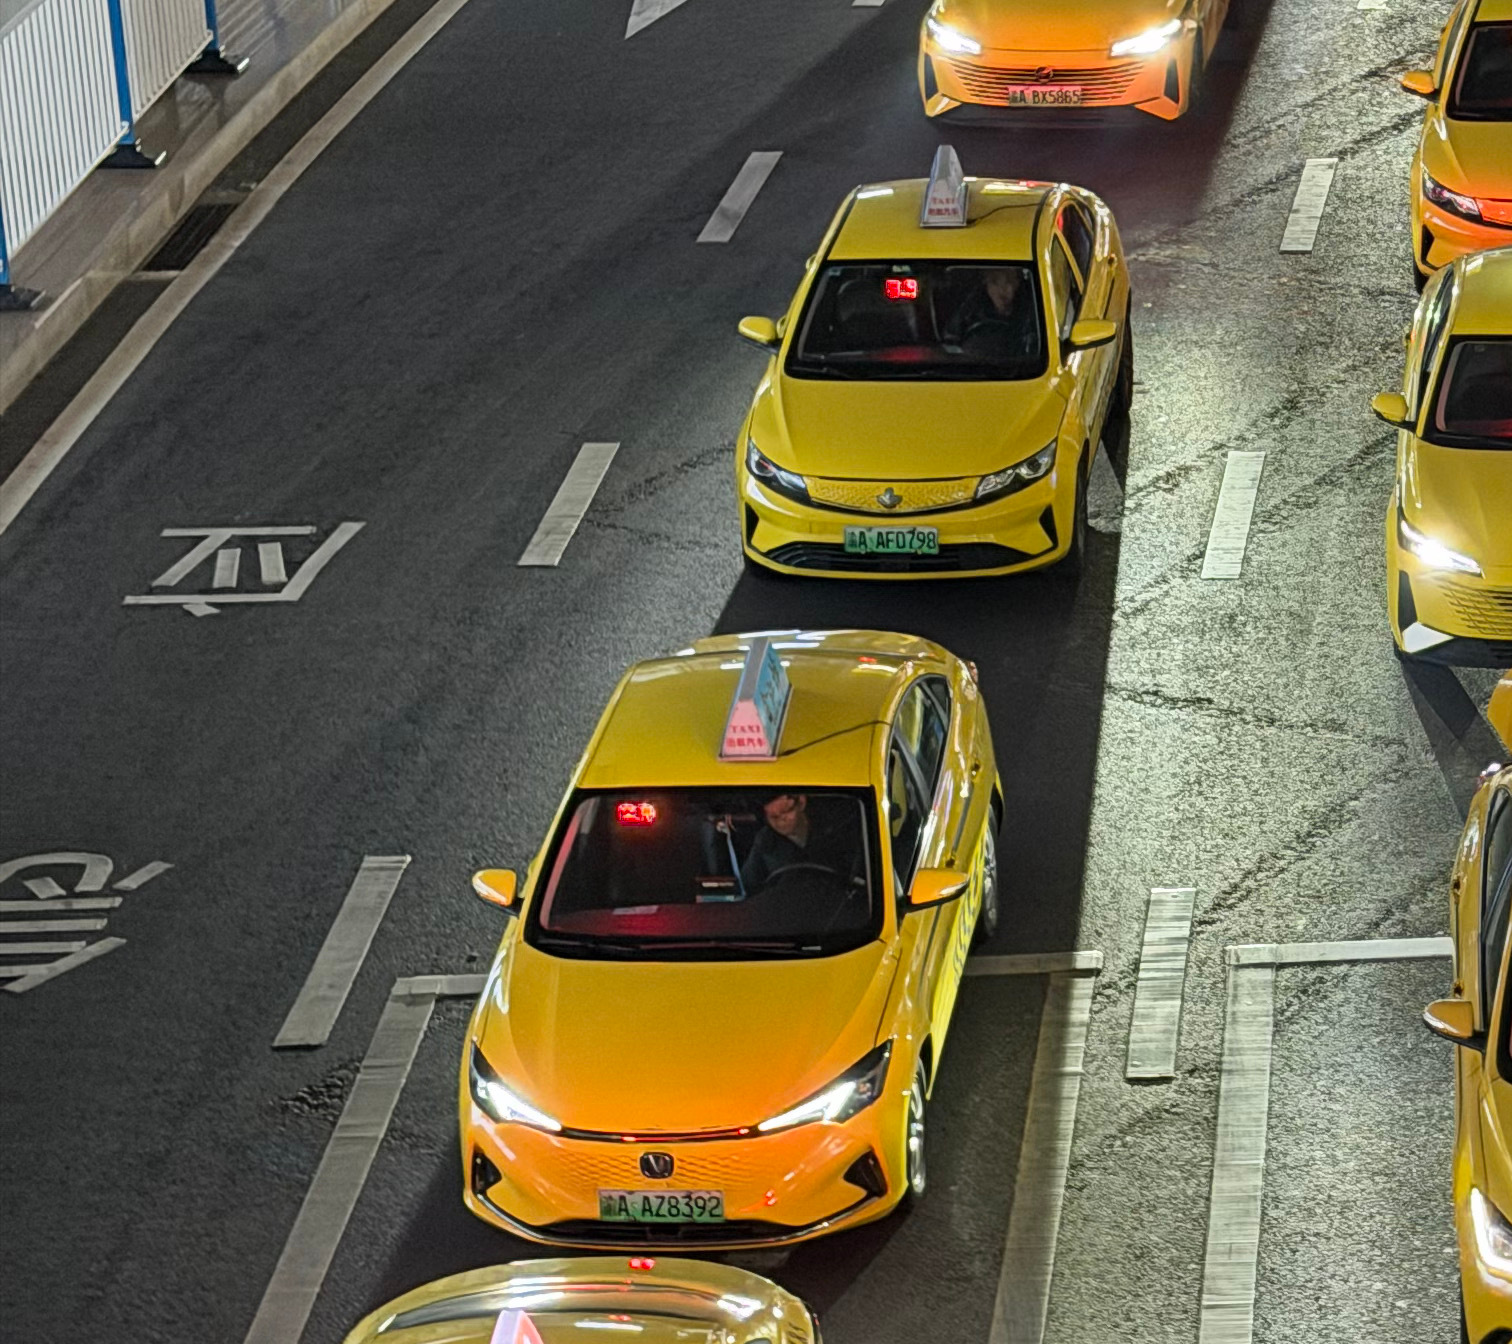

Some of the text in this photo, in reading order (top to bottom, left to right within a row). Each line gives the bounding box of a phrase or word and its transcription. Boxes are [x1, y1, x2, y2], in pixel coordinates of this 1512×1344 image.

[1032, 89, 1081, 105] BX5865
[731, 724, 761, 733] TAXI
[726, 737, 765, 748] 出租汽车
[641, 1194, 722, 1218] AZ8392
